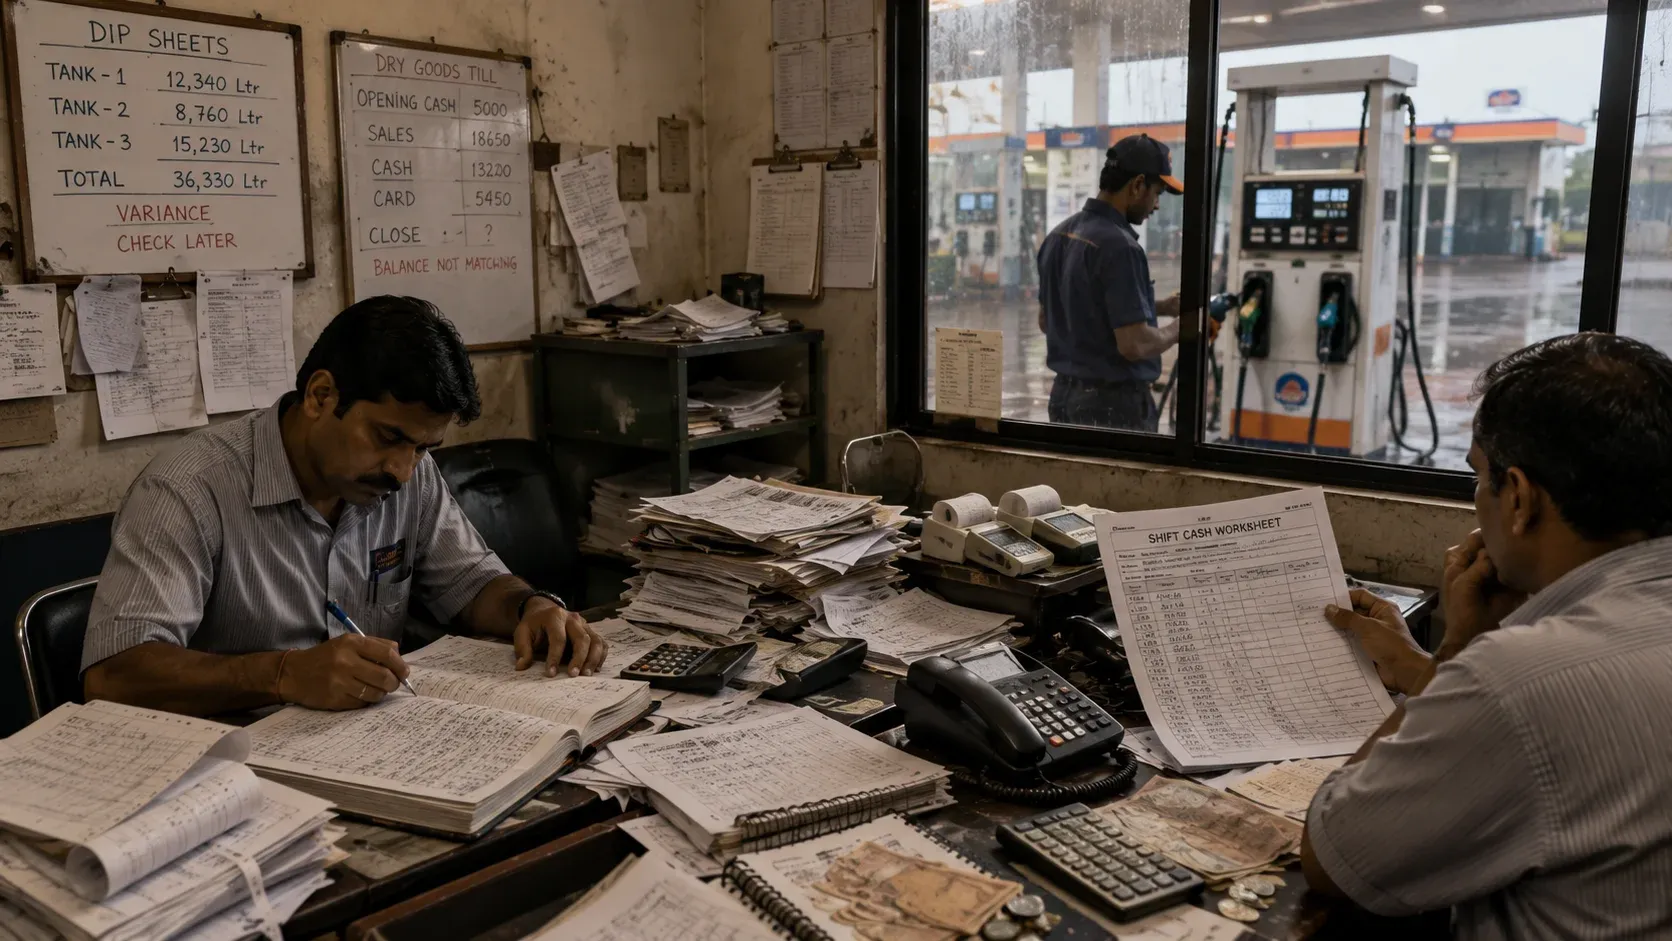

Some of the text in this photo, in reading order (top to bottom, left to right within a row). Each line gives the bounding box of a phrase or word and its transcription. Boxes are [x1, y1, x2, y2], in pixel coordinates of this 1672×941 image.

[89, 21, 229, 55] DIP SHEETS
[375, 53, 497, 84] DRY GOODS TILL
[166, 71, 227, 91] 12,340
[236, 78, 260, 94] Ltr
[357, 89, 507, 117] OPENING CASH 5000
[176, 103, 228, 124] 8,760
[239, 109, 262, 124] Ltr
[173, 136, 230, 155] 15,230
[241, 139, 264, 154] Ltr
[368, 125, 510, 148] SALES 18650
[372, 159, 412, 175] CASH
[58, 170, 267, 192] TOTAL 36,330 Ltr
[374, 190, 511, 207] CARD 5450
[116, 205, 211, 222] VARIANCE
[118, 233, 237, 252] CHECK LATER
[369, 224, 492, 244] CLOSE ?
[374, 256, 517, 276] BALANCE NOT MATCHING
[1148, 531, 1180, 544] SHIFT
[1183, 528, 1212, 540] CASH
